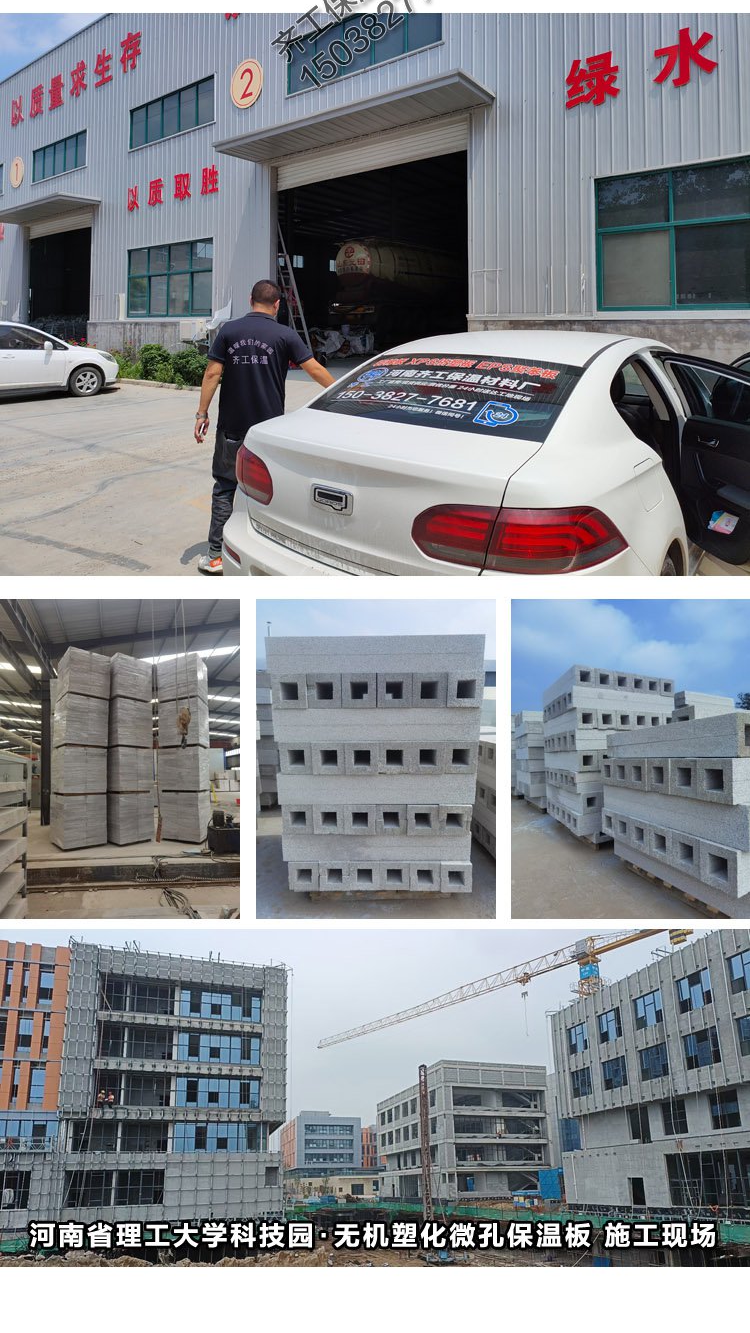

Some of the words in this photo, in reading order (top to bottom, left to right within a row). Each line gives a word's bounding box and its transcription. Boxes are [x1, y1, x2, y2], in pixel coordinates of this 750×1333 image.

[11, 31, 142, 127] 以质量求生存
[240, 68, 253, 100] 2
[566, 27, 718, 109] 绿水
[127, 164, 219, 212] 以质取胜
[232, 355, 268, 365] 齐工保温
[386, 368, 541, 390] 河南齐工保温材料厂
[337, 390, 478, 411] 150-3827-7681
